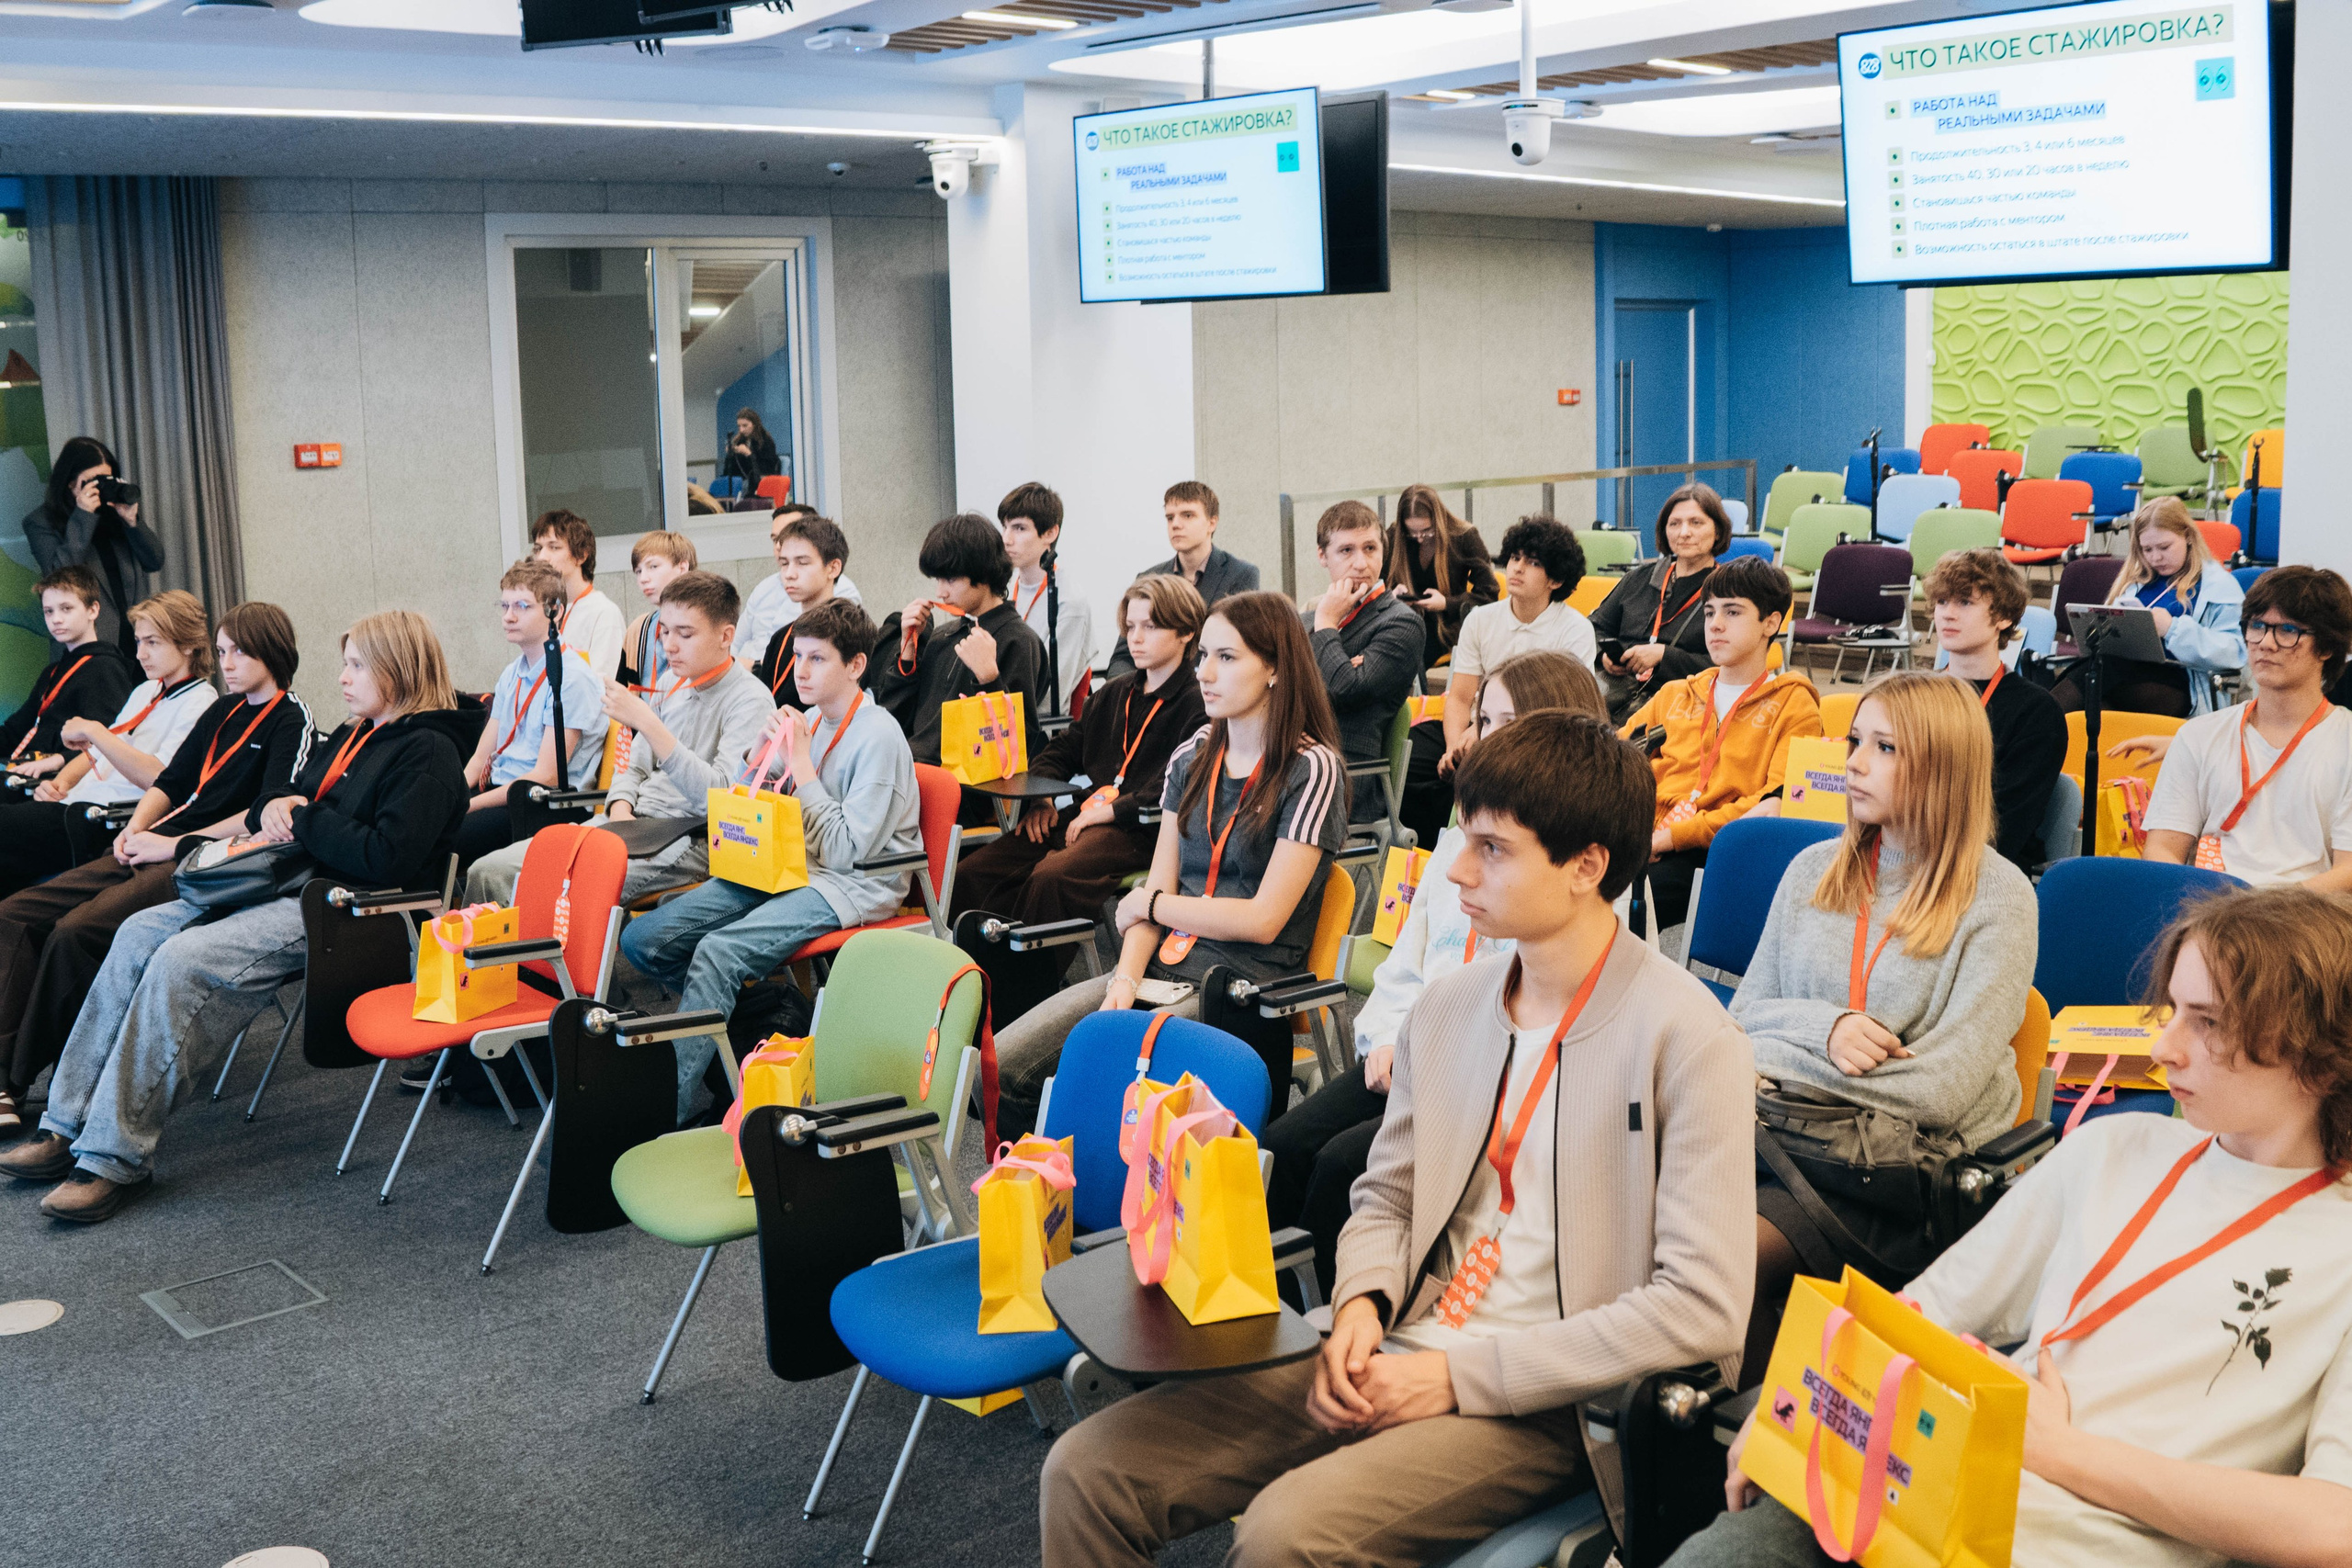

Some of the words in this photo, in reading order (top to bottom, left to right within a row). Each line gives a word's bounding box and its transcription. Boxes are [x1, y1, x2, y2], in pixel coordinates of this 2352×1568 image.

[1890, 48, 1937, 71] ЧТО
[1942, 37, 2022, 65] ТАКОЕ
[2028, 13, 2224, 56] СТАЖИРОВКА?
[1913, 96, 1965, 112] РАБОТА
[1968, 93, 1997, 107] НАД
[1938, 110, 2023, 130] РЕАЛЬНЫМИ
[2026, 102, 2105, 122] ЗАДАЧАМИ
[1103, 128, 1131, 145] ЧТО
[1133, 122, 1179, 141] ТАКОЕ
[1182, 109, 1293, 137] СТАЖИРОВКА?
[1116, 165, 1148, 176] РАБОТА
[1148, 163, 1166, 174] НАД
[1131, 176, 1180, 189] РЕАЛЬНЫМИ
[1182, 172, 1227, 186] ЗАДАЧАМИ
[1805, 771, 1832, 782] ВСЕГДА
[1812, 781, 1838, 792] ВСЕГДА
